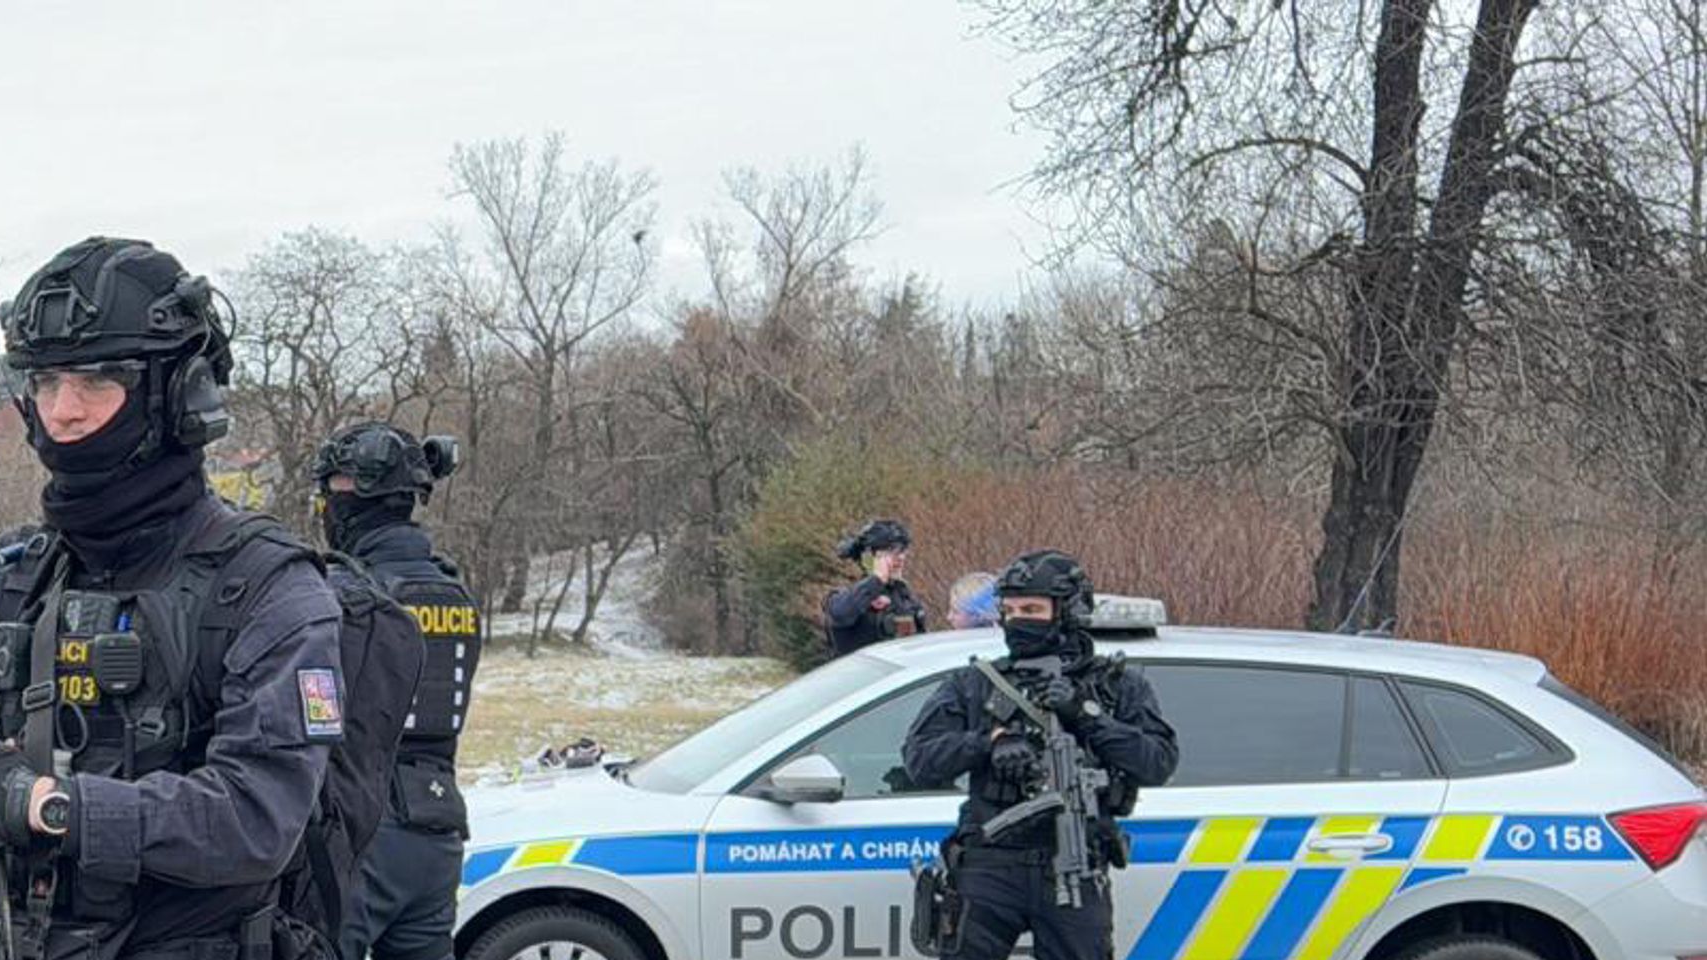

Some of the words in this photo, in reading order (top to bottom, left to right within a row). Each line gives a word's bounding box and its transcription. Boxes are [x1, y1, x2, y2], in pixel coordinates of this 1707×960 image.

[58, 676, 95, 700] 103
[730, 841, 835, 862] POMÁHAT
[841, 843, 855, 859] A
[862, 838, 941, 859] CHRÁN
[1543, 824, 1603, 851] 158
[730, 904, 944, 959] POLI
